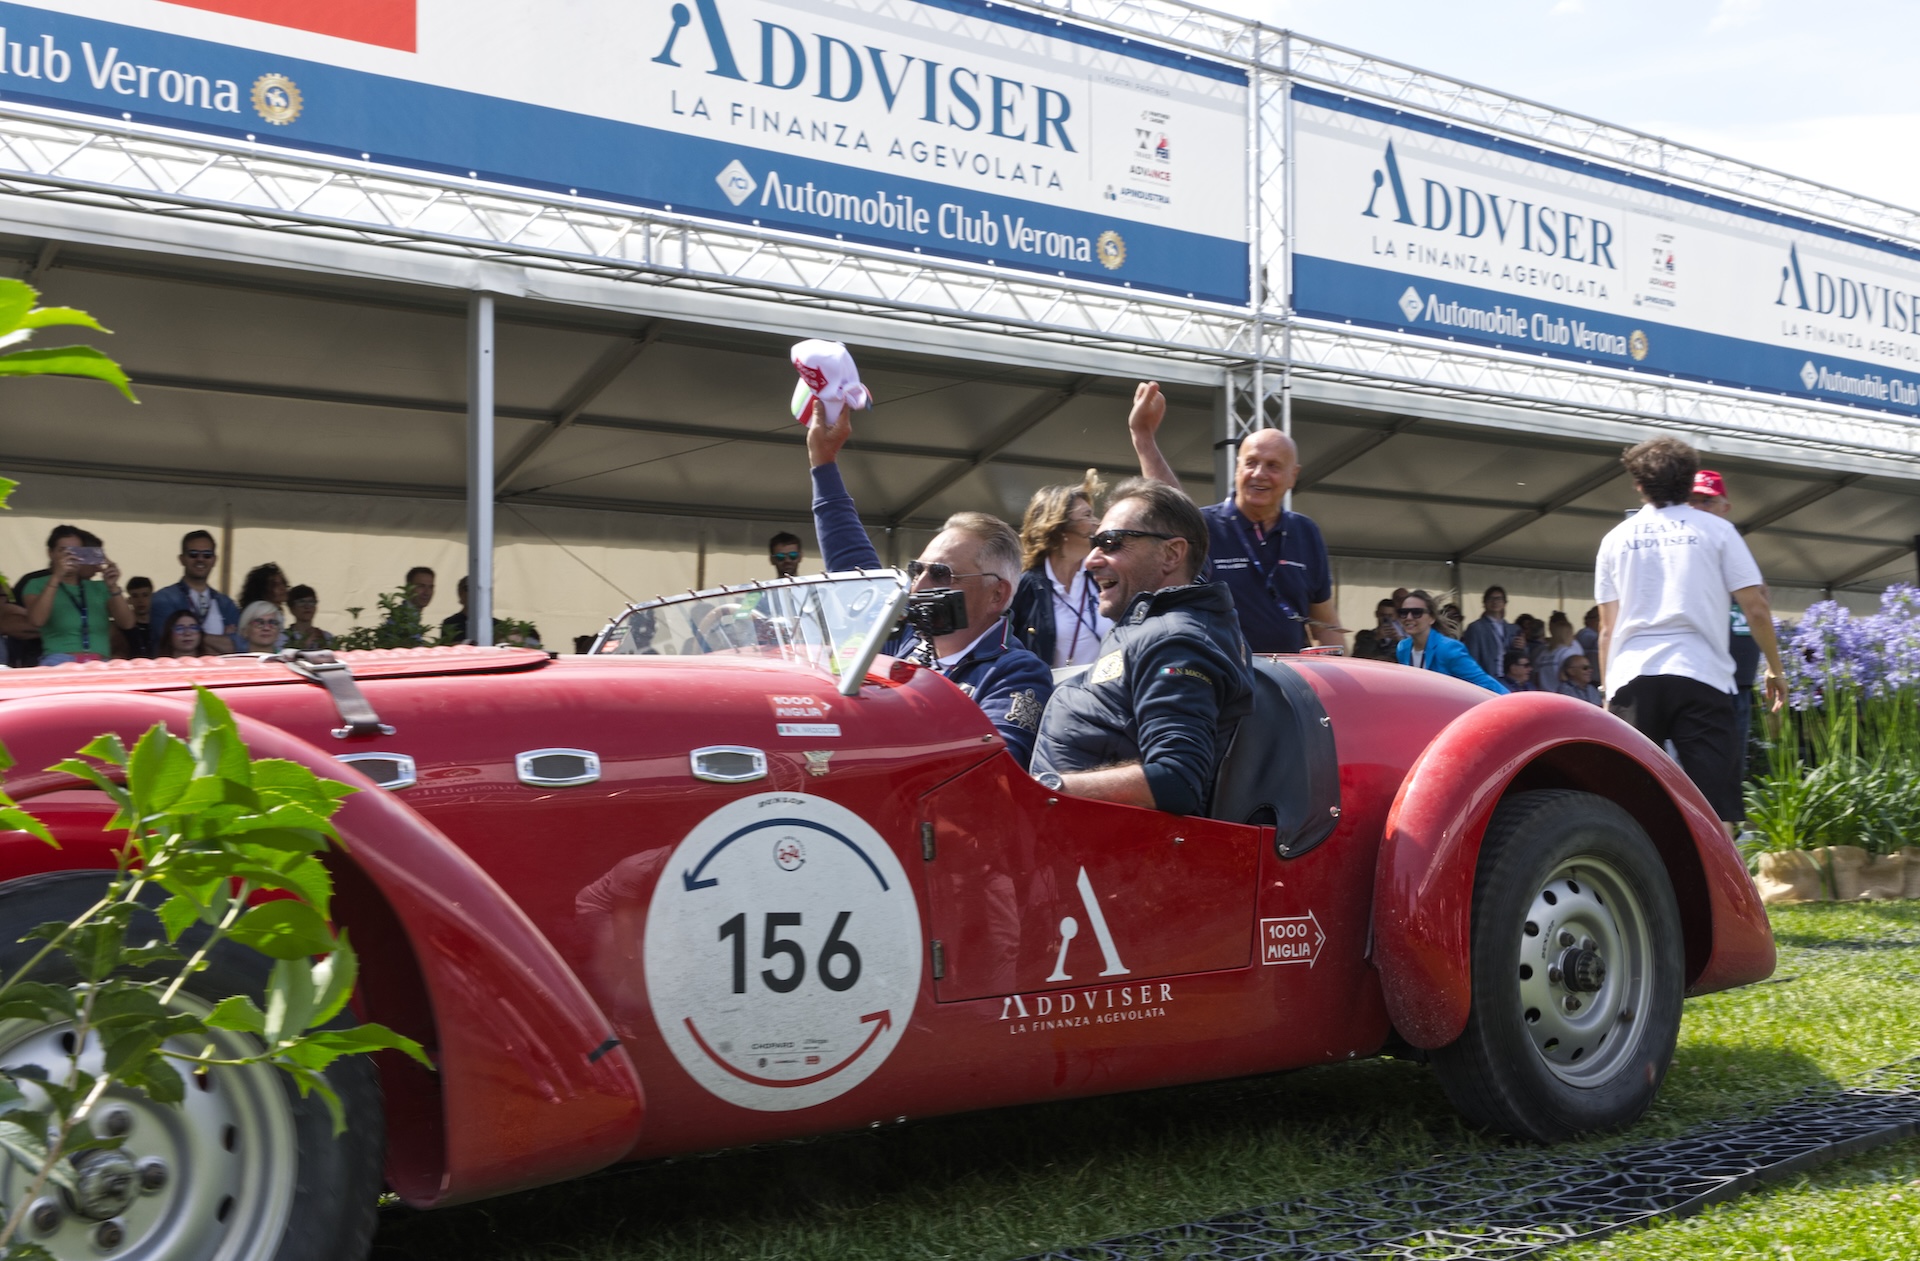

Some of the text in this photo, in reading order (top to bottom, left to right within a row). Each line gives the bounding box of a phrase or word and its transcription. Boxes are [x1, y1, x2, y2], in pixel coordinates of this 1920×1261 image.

[80, 41, 241, 114] Verona
[650, 0, 1079, 153] ADDVISER
[671, 90, 1064, 192] LA FINANZA AGEVOLATA
[759, 171, 1093, 263] Automobile Club Verona
[1360, 137, 1617, 270] ADDVISER
[1372, 235, 1609, 300] LA FINANZA AGEVOLATA
[1425, 293, 1628, 356] Automobile Club Verona
[1781, 321, 1799, 338] LA
[1805, 325, 1864, 351] FINANZA
[1817, 366, 1889, 401] Automobile
[1889, 379, 1918, 406] Club
[1622, 535, 1700, 554] ADDVISER
[1634, 520, 1686, 535] TEAM
[773, 696, 815, 706] 1000
[776, 707, 823, 717] MIGLIA
[1267, 942, 1311, 959] MIGLIA
[1268, 923, 1308, 939] 1000
[718, 911, 862, 994] 156
[999, 983, 1174, 1021] ADDVISER
[1010, 1007, 1166, 1035] LA FINANZA AGEVOLATA
